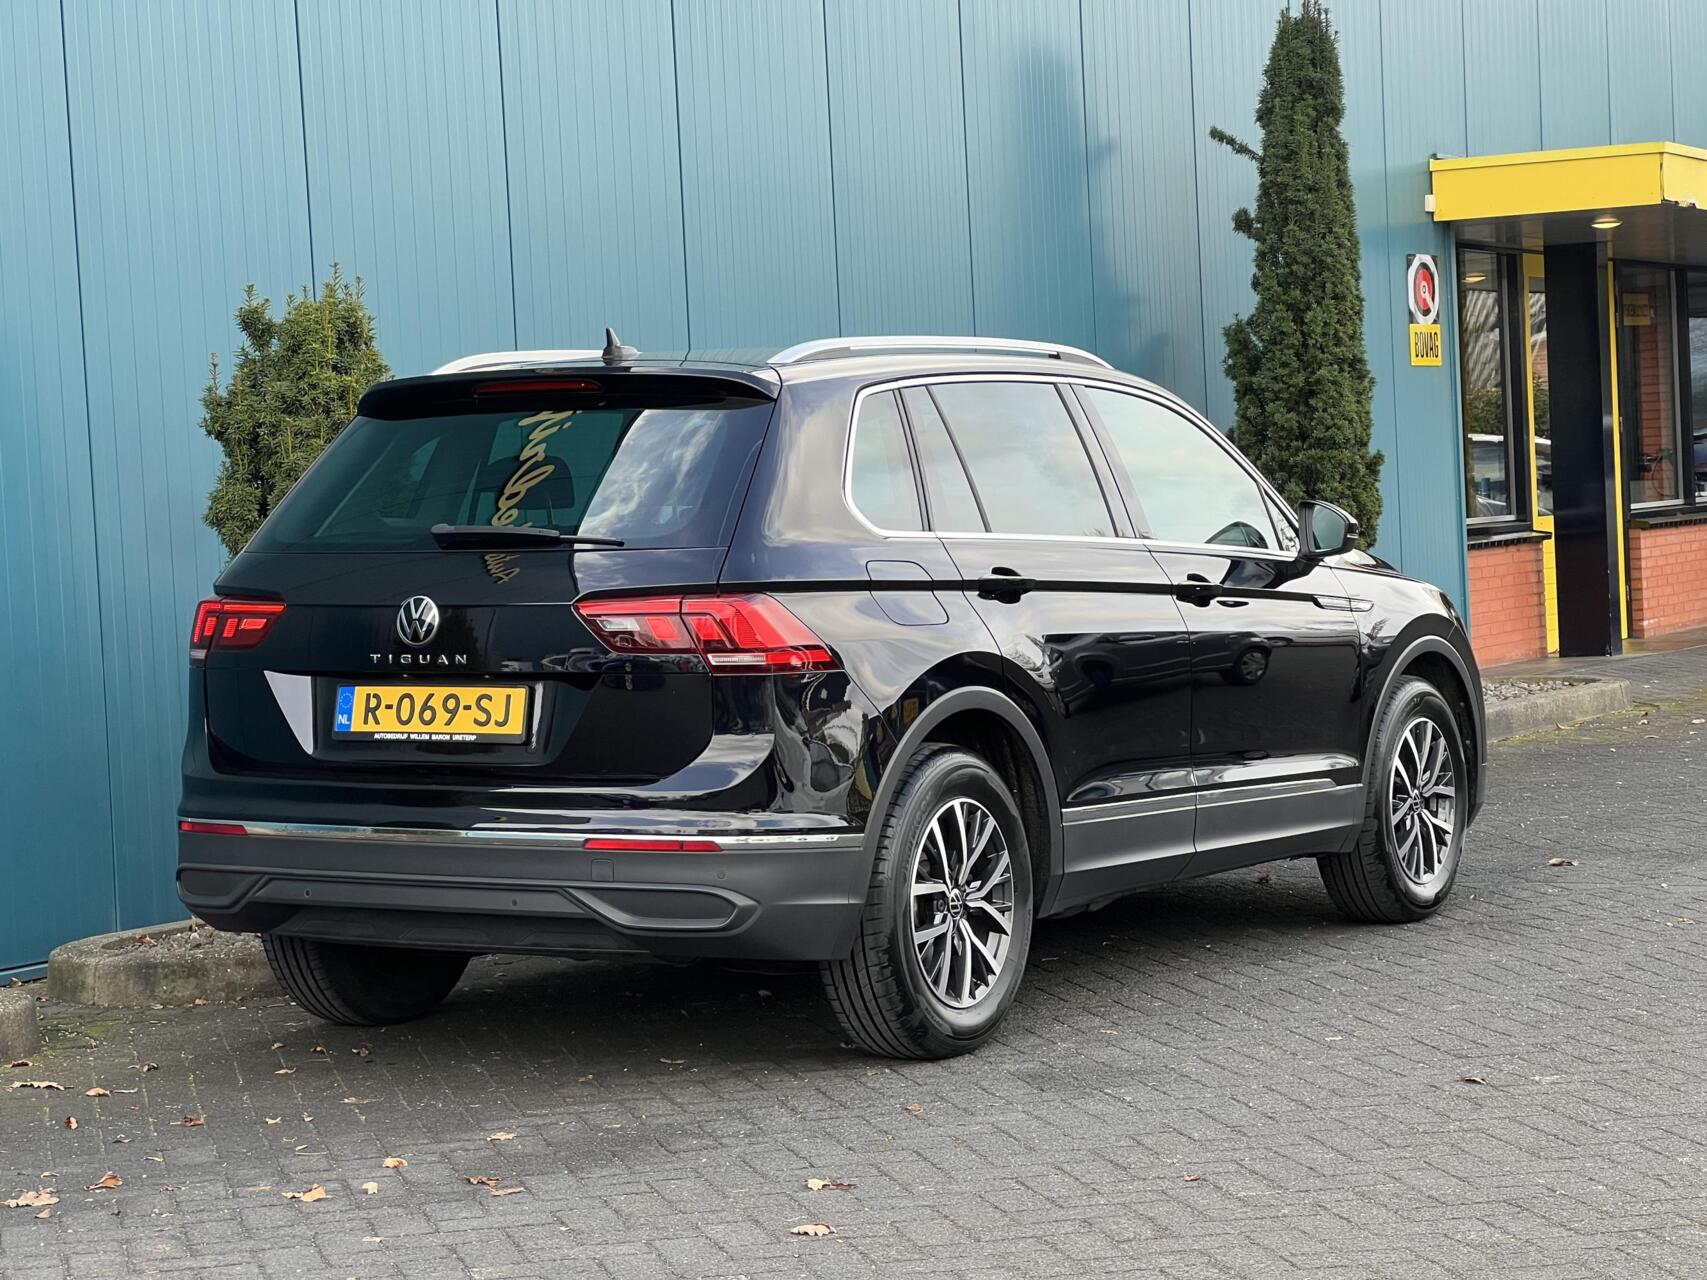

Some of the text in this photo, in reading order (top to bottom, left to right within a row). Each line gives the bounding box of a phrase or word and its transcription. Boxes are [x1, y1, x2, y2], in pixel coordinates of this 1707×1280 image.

[1414, 331, 1439, 358] BOVAG
[369, 653, 467, 665] TIGUAN
[363, 692, 512, 727] R-069-SJ
[337, 713, 350, 725] NL
[374, 732, 409, 740] AUTOBEDRIJF
[431, 733, 451, 741] BARON
